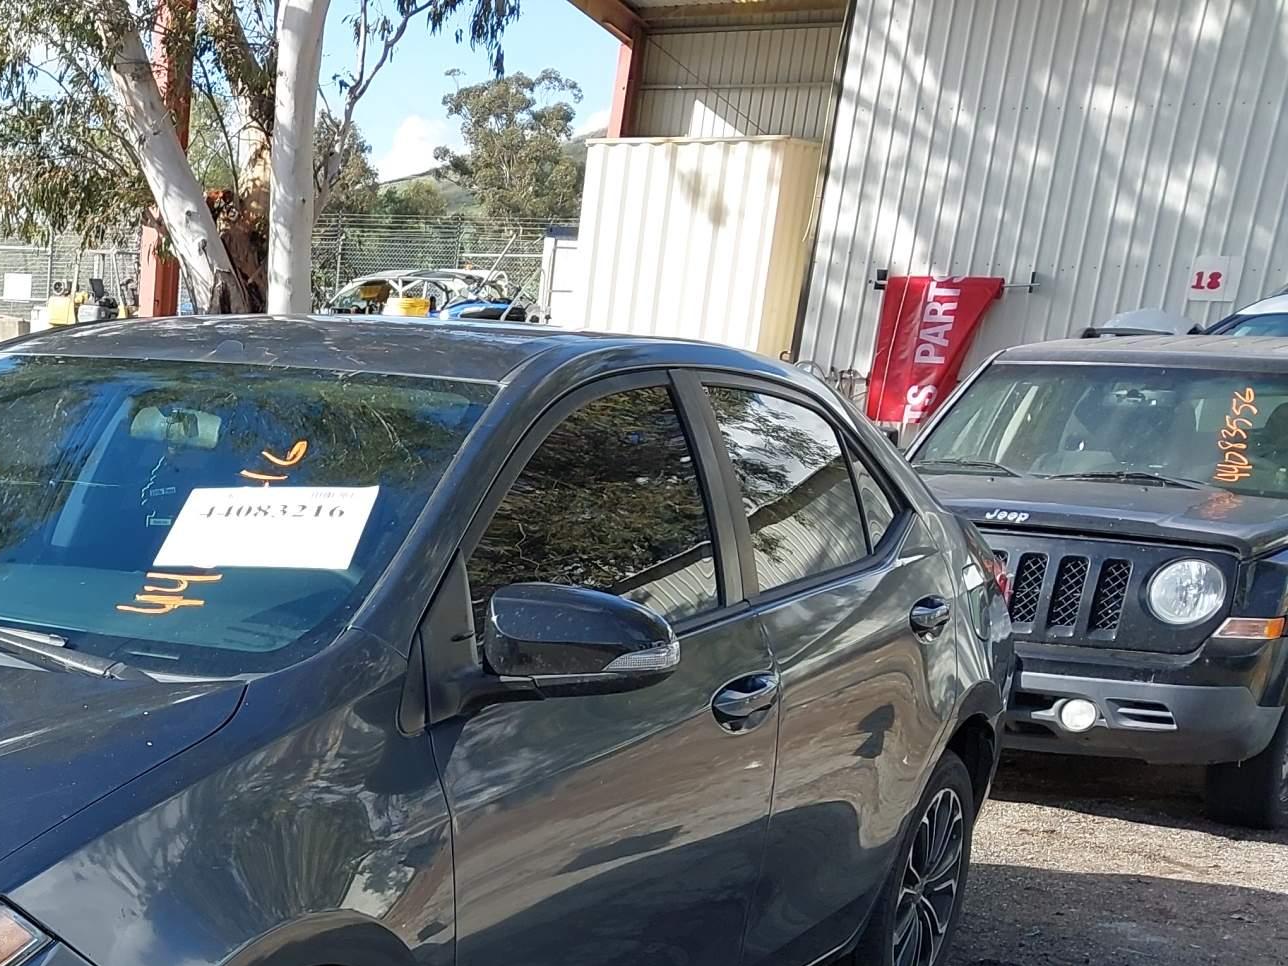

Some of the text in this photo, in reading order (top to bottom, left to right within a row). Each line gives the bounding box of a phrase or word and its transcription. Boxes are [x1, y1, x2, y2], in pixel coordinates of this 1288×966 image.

[1191, 270, 1223, 291] 18
[1213, 387, 1258, 483] 44083556
[200, 504, 346, 518] 44083216
[985, 508, 1030, 524] Jeep
